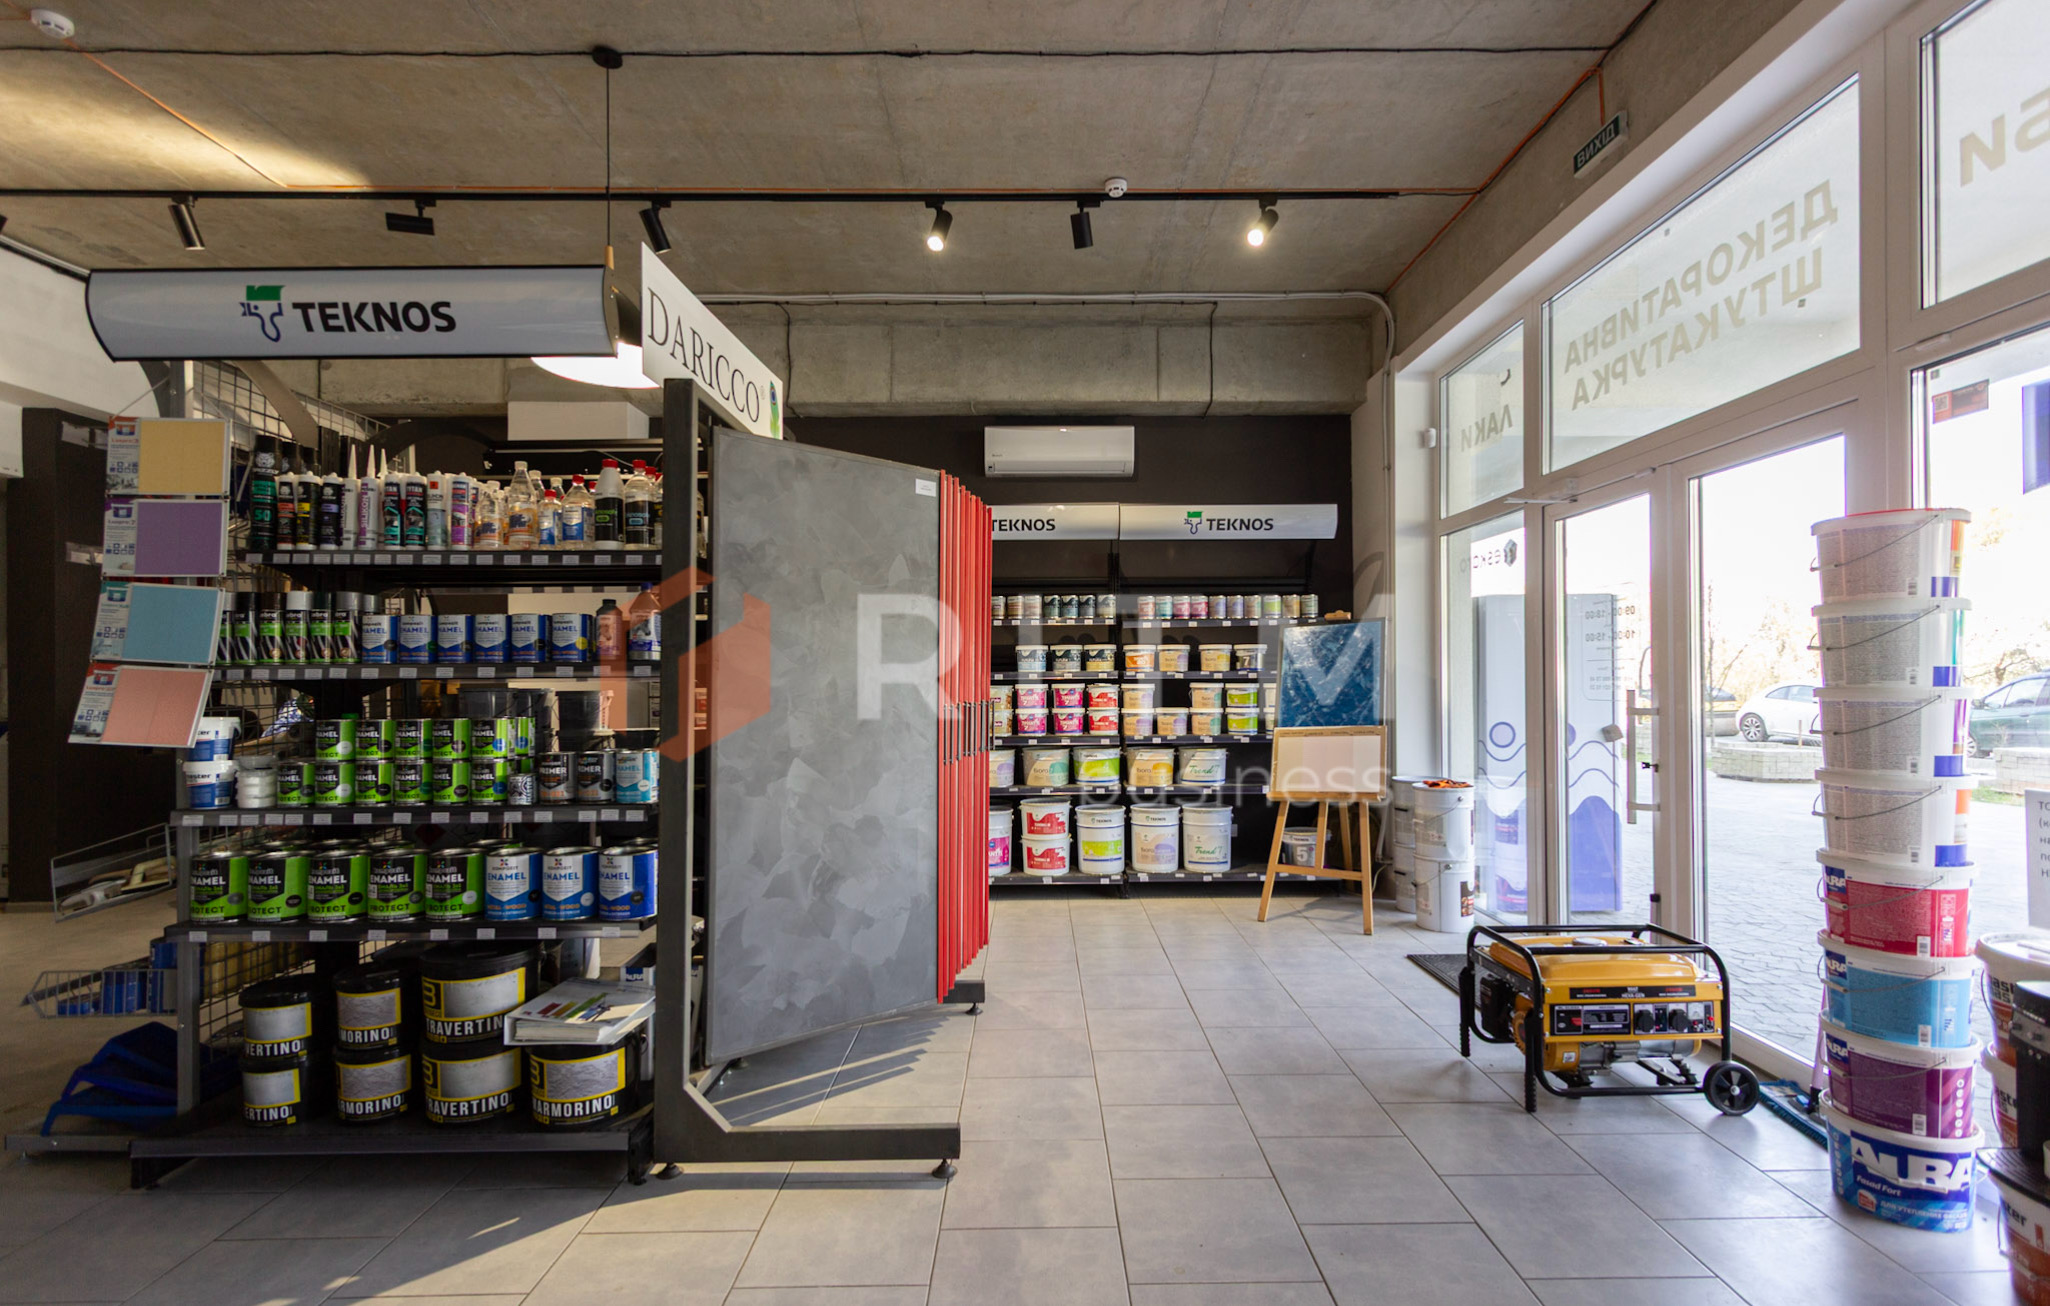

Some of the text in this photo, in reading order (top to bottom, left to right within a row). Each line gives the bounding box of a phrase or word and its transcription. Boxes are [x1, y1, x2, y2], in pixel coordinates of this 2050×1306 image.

[1576, 122, 1616, 169] ВИХІД
[292, 300, 456, 333] TEKNOS
[647, 286, 760, 423] DARICCO
[991, 518, 1056, 532] TEKNOS
[1206, 518, 1274, 532] TEKNOS
[1296, 846, 1308, 862] 5
[308, 875, 348, 885] ENAMEL
[370, 873, 412, 884] ENAMEL
[427, 873, 465, 883] ENAMEL
[488, 872, 527, 881] ENAMEL
[544, 872, 580, 881] ENAMEL
[600, 872, 630, 880] NAMEL
[426, 1015, 504, 1037] TRAVERTIN
[339, 1026, 390, 1044] MORINO
[246, 1039, 301, 1057] ERTINO
[338, 1094, 401, 1115] RMORINO
[245, 1105, 290, 1122] ERTINO
[1856, 1174, 1902, 1197] Fasad Fort
[2006, 1201, 2028, 1227] ter
